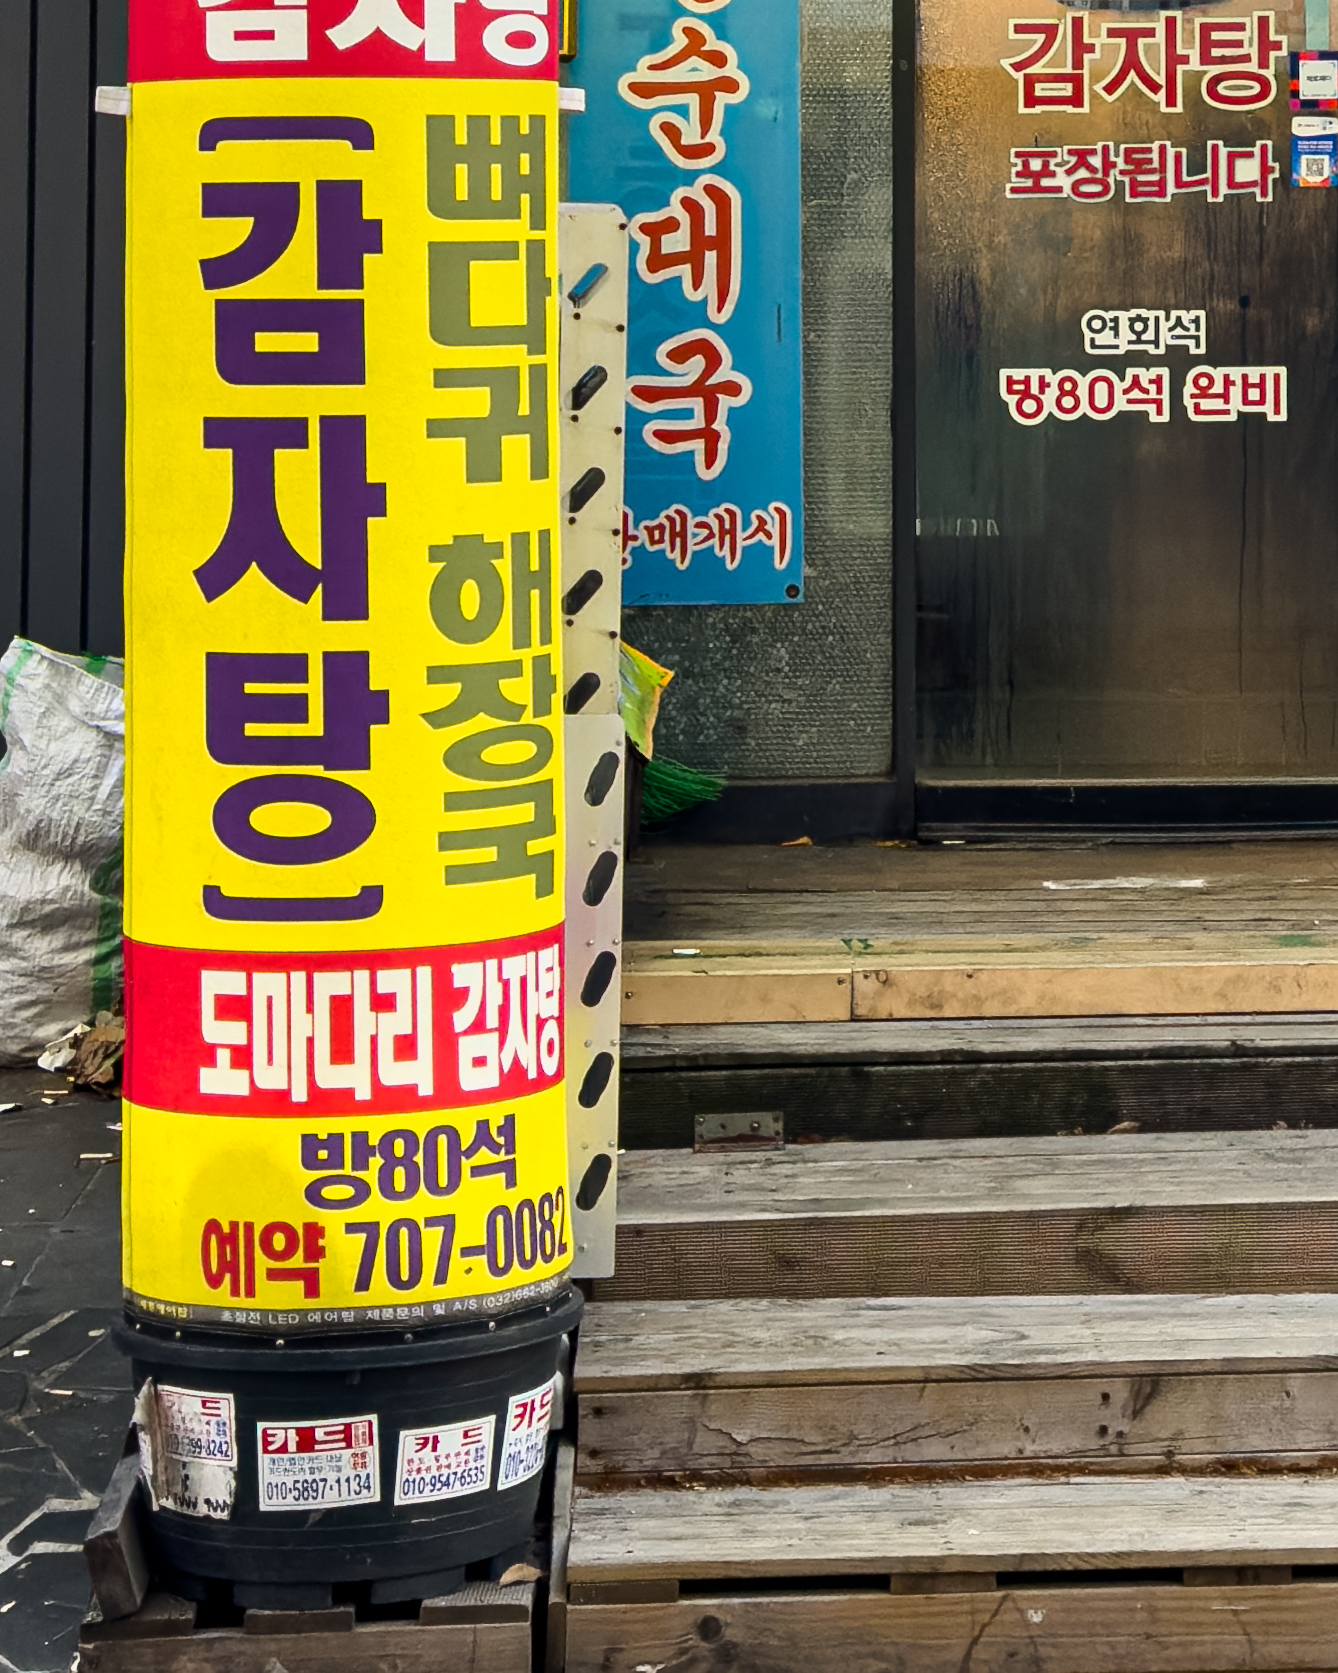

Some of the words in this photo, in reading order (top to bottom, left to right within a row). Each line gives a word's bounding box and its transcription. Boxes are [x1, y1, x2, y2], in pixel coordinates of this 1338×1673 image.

[1008, 13, 1285, 110] 감자탕
[1009, 143, 1276, 200] 포장됩니다
[424, 112, 552, 485] 뼈다귀
[1087, 313, 1203, 350] 연회석
[1005, 372, 1165, 420] 방80석
[1189, 370, 1283, 416] 완비
[418, 528, 558, 901] 해장국
[199, 963, 434, 1103] 도마다리
[450, 943, 562, 1094] 감자탕
[300, 1113, 518, 1212] 방80석
[200, 1217, 325, 1300] 예약
[344, 1186, 569, 1295] 707-0082
[268, 1312, 300, 1325] LED
